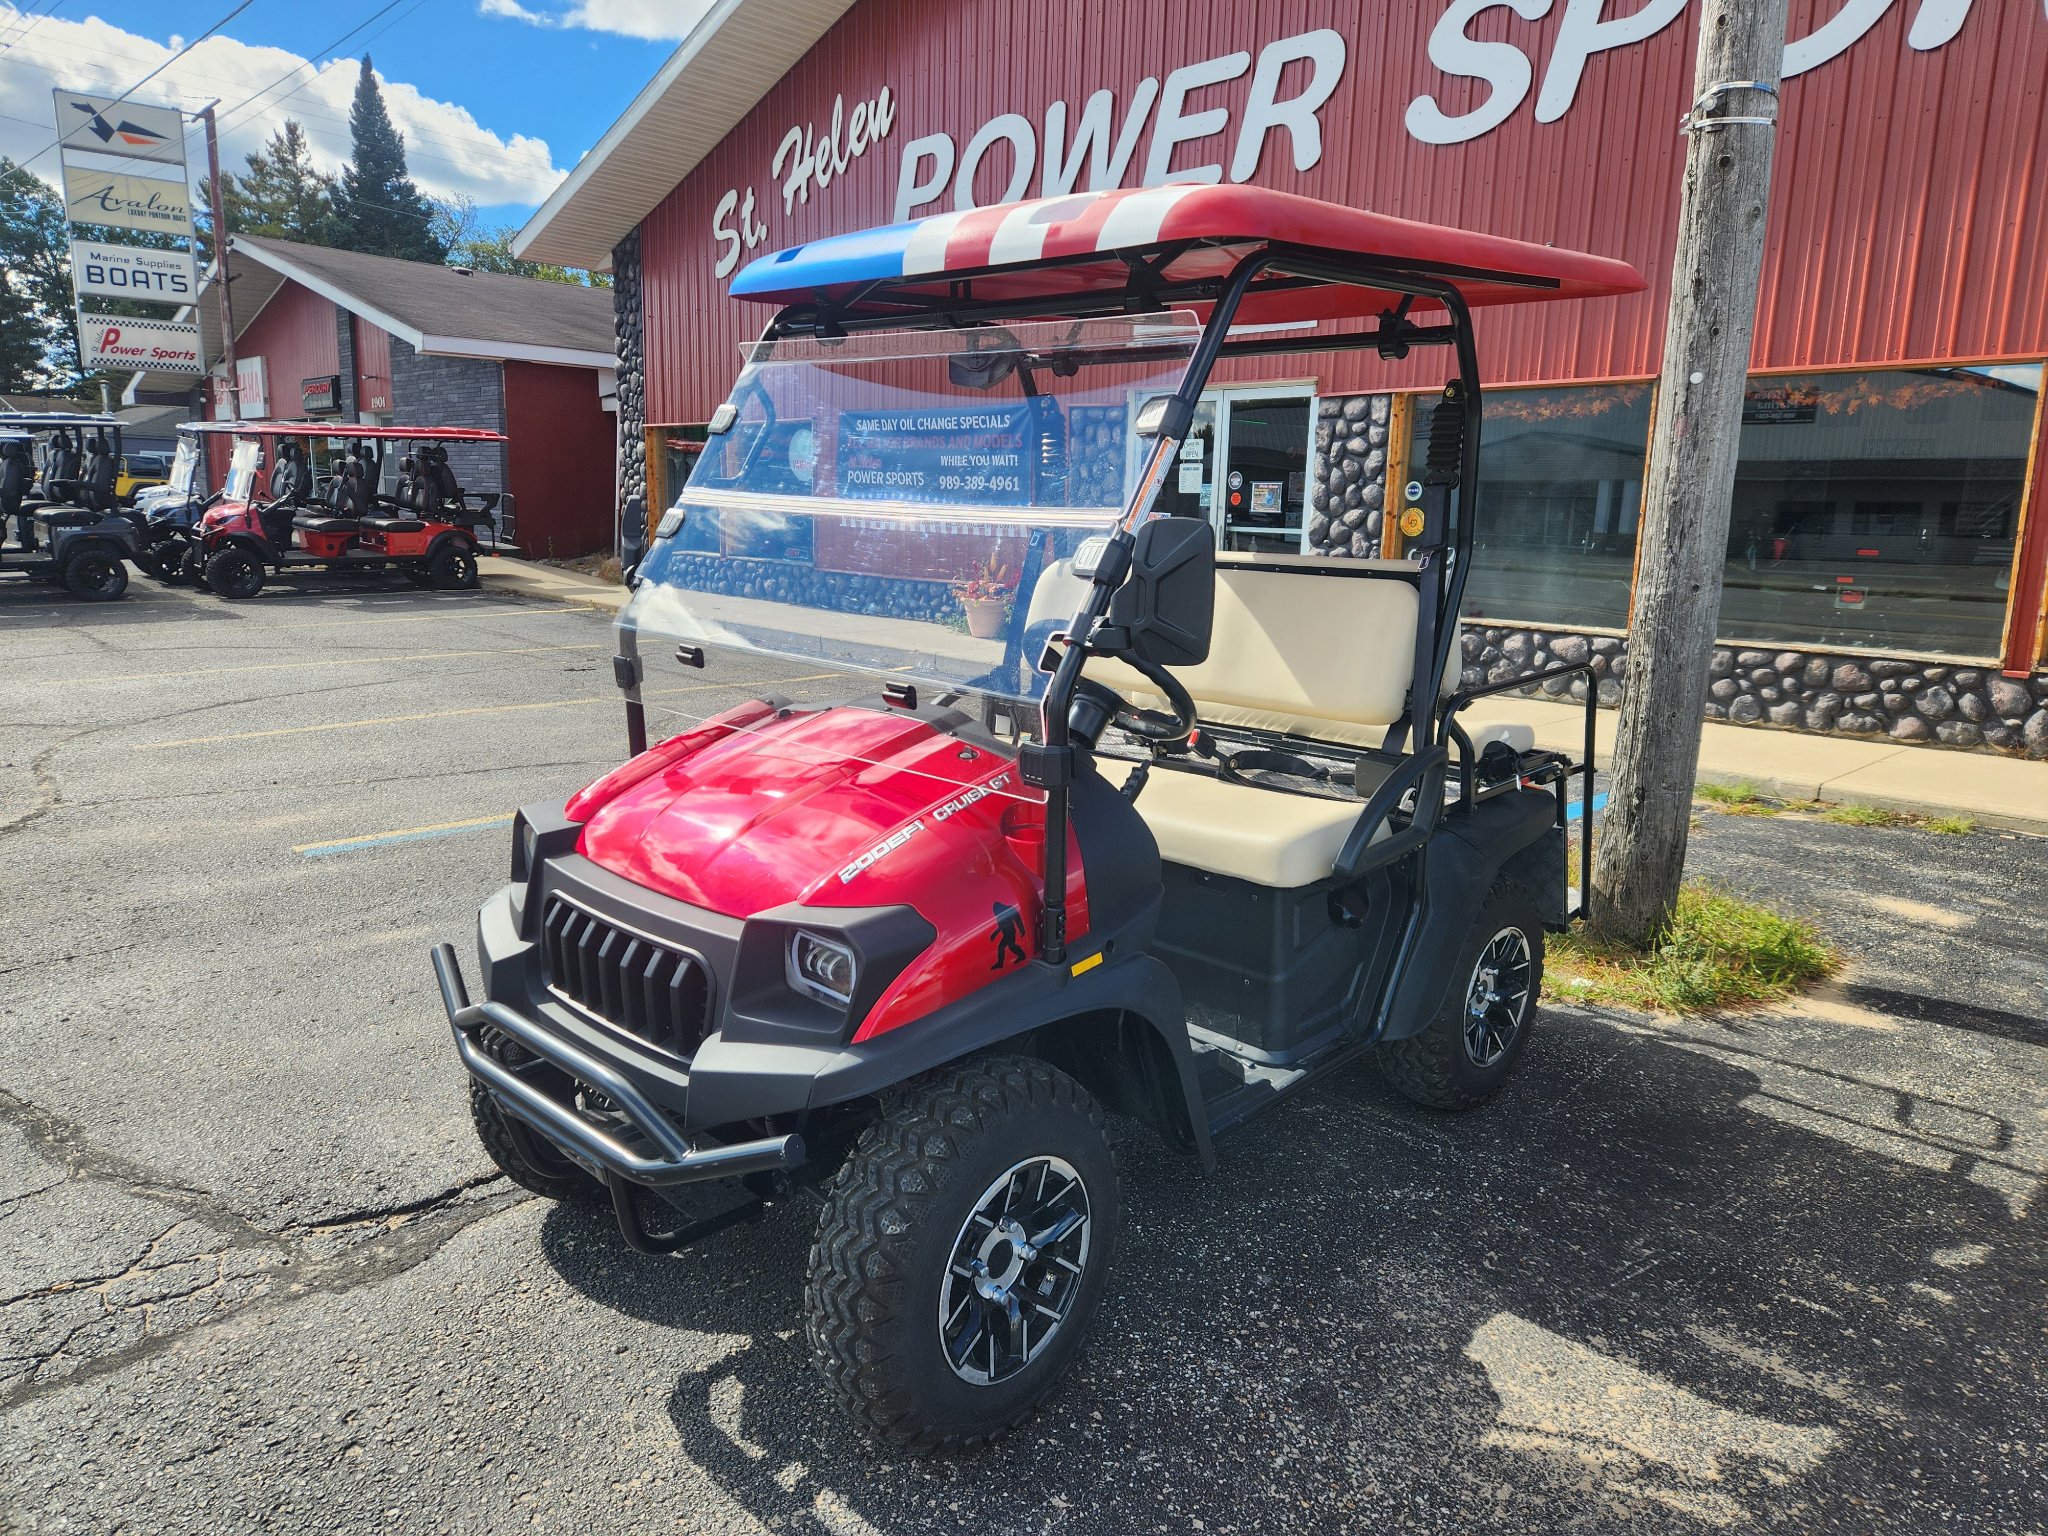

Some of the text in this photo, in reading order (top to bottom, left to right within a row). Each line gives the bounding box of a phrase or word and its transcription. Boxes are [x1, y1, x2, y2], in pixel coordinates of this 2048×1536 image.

[893, 28, 1347, 224] POWER
[713, 86, 897, 279] St. Helen
[70, 185, 187, 214] Avalon
[90, 252, 182, 270] Marine Supplies
[86, 264, 188, 293] BOATS
[100, 327, 197, 360] Power Sports
[371, 397, 386, 409] 1901
[856, 415, 1011, 431] SAME DAY OIL CHANGE SPECIALS
[949, 434, 972, 448] AND
[973, 433, 1022, 448] MODELS
[940, 455, 1018, 467] WHILE YOU WAIT!
[848, 471, 925, 486] POWER SPORTS
[939, 475, 1020, 491] 989-389-4961
[838, 772, 1012, 884] 200EFI CRUISE GT
